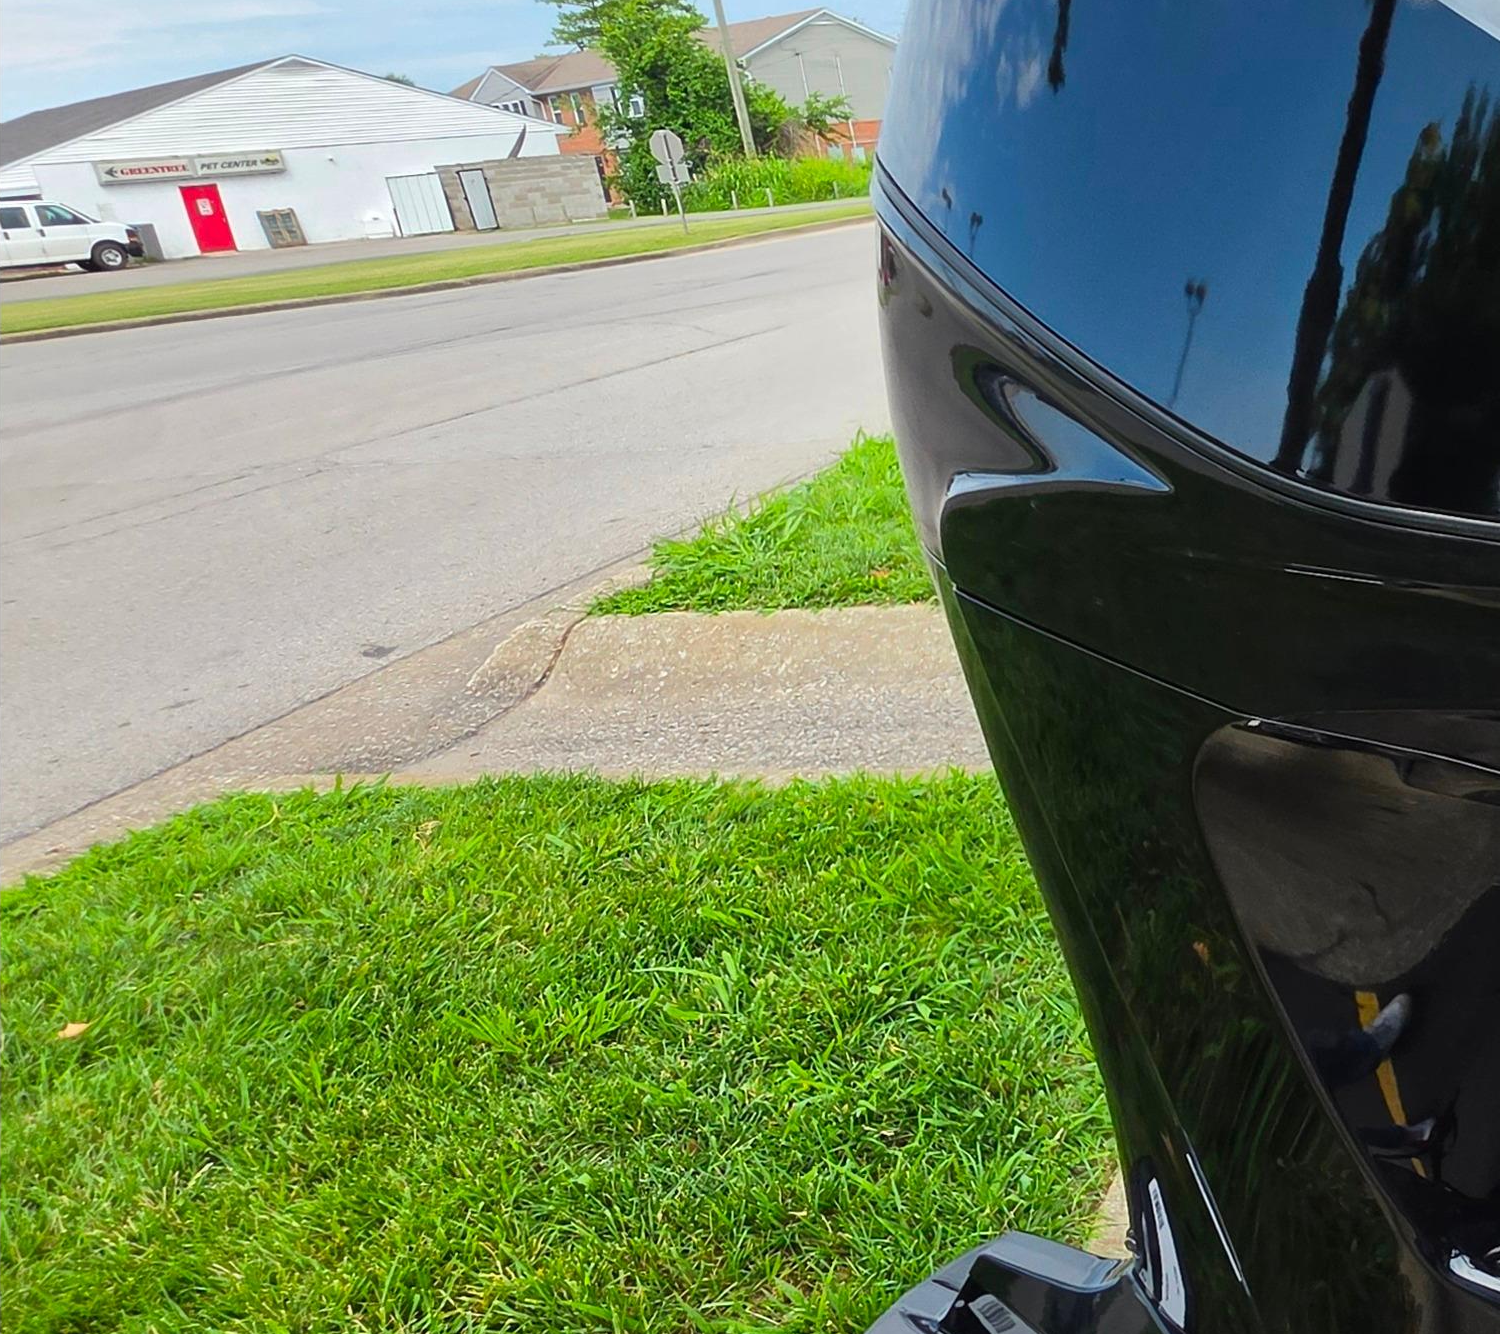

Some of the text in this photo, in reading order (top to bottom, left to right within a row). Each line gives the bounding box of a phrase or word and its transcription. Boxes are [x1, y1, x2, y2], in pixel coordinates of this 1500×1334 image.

[120, 159, 258, 176] GREENTREE PET CENTER
